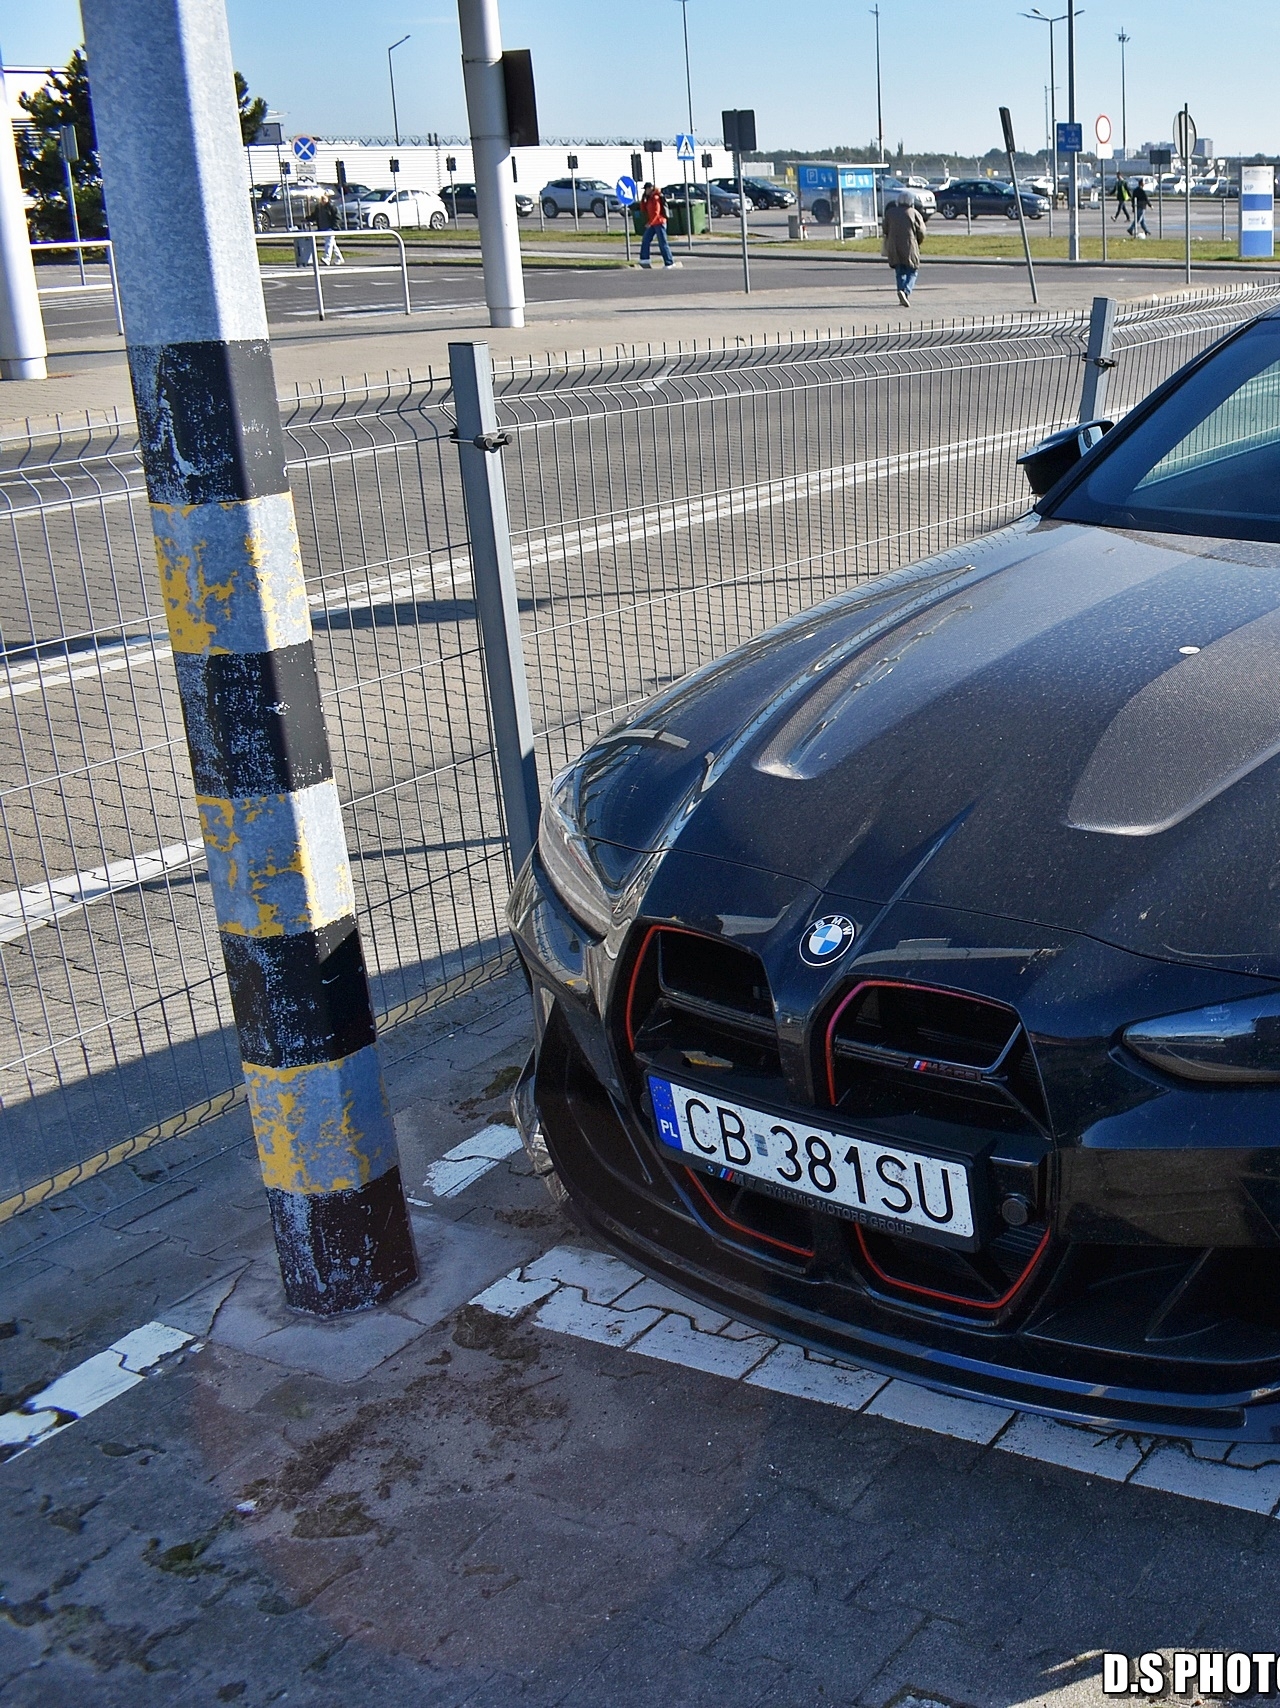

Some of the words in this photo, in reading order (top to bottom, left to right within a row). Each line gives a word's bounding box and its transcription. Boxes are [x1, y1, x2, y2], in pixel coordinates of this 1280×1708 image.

[814, 916, 853, 935] BMW
[660, 1119, 678, 1138] PL
[685, 1098, 752, 1166] CB
[769, 1125, 954, 1224] 381SU
[763, 1183, 814, 1207] DYNAMIC
[816, 1200, 867, 1224] MOTORS
[869, 1216, 913, 1236] GROUP
